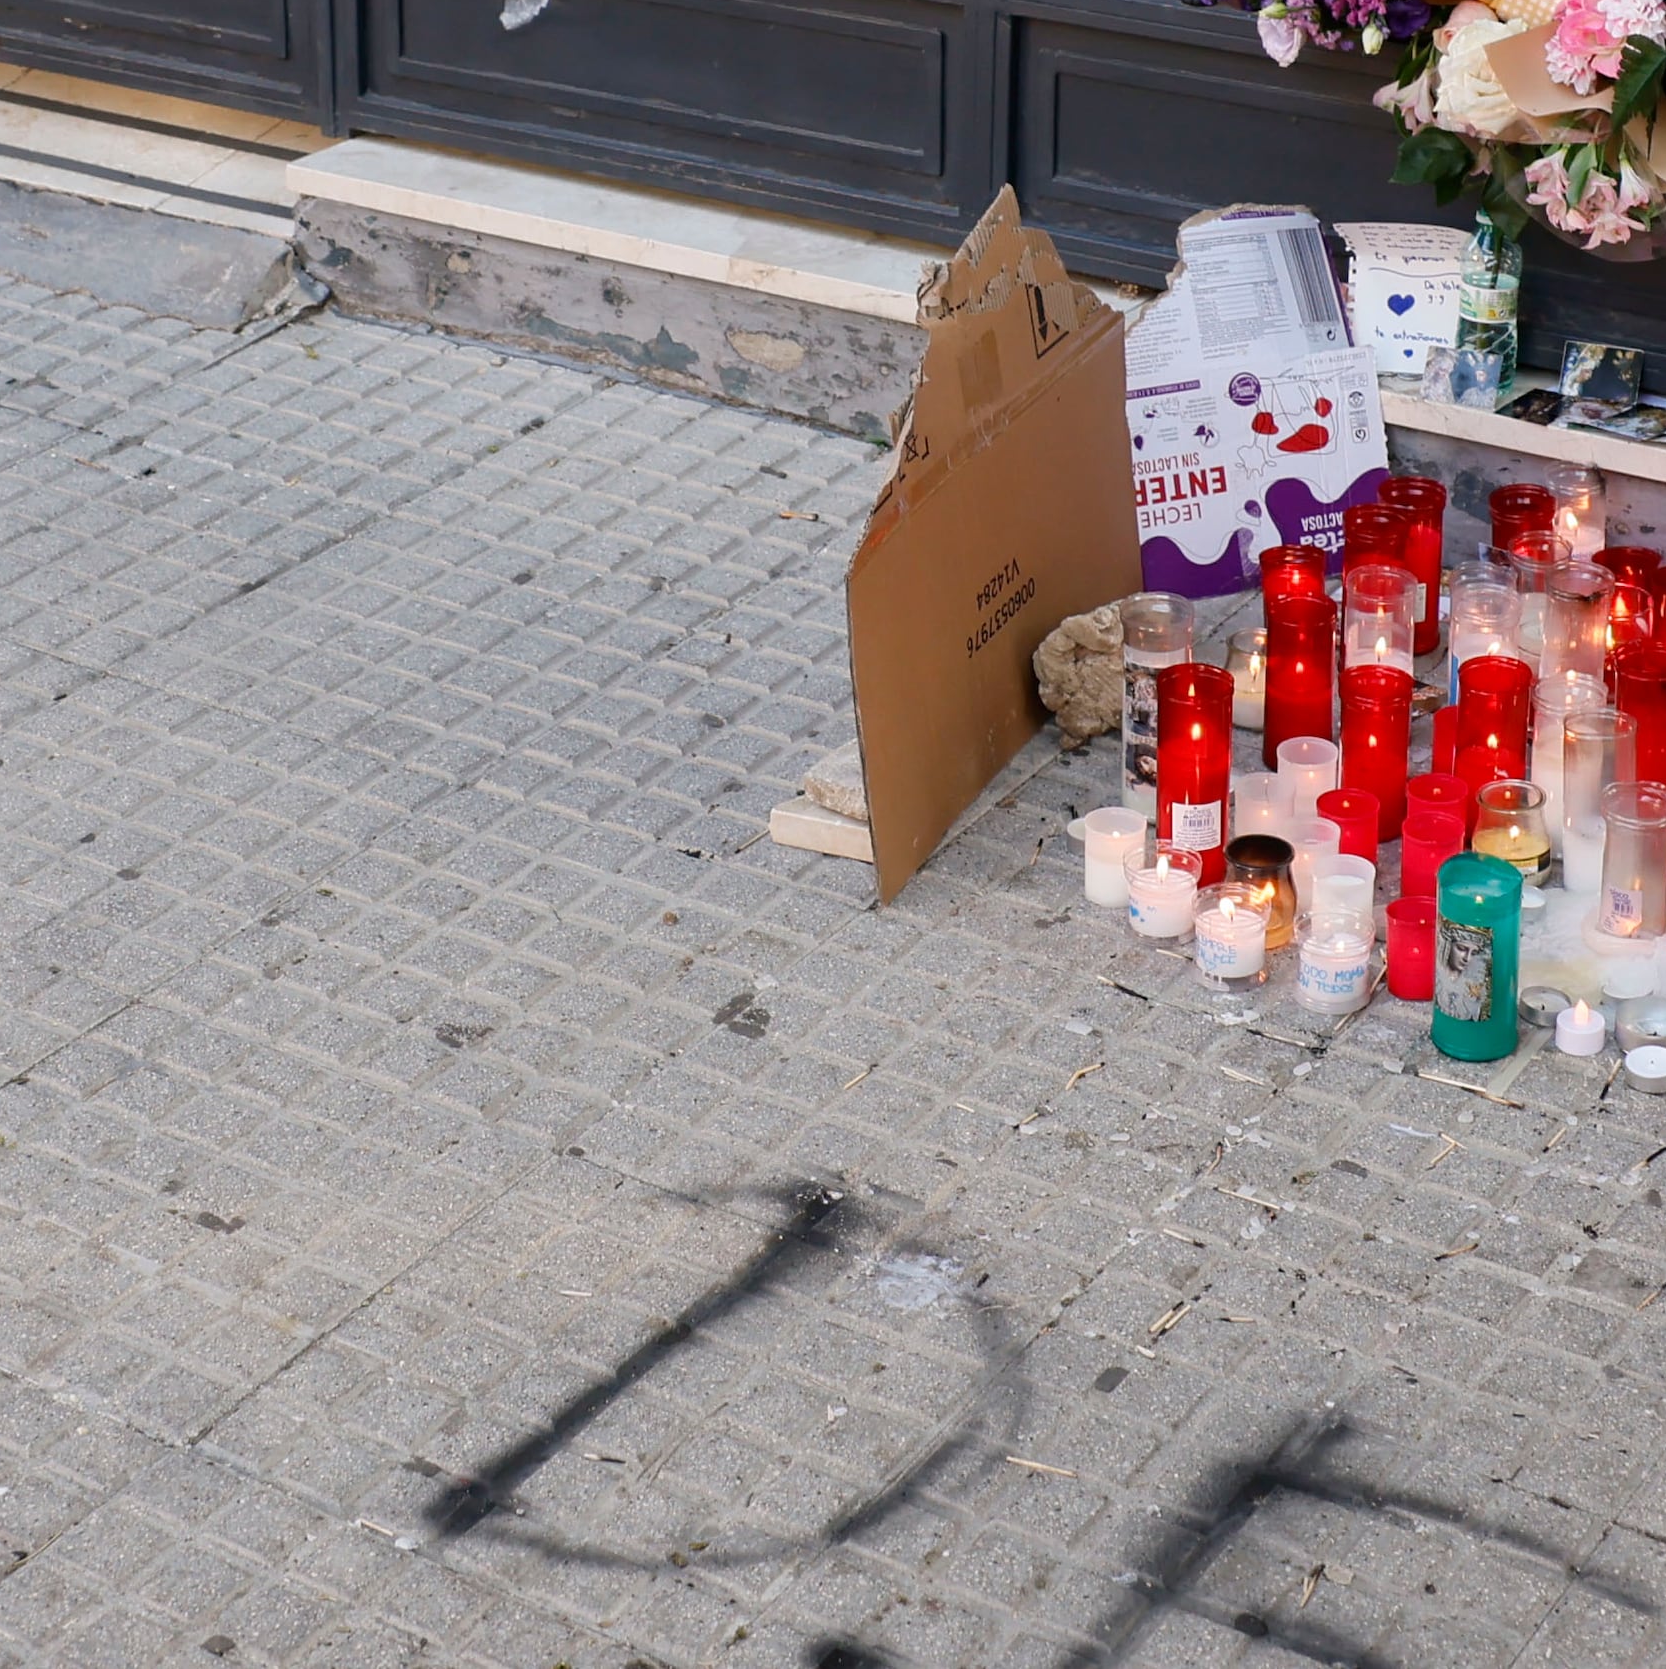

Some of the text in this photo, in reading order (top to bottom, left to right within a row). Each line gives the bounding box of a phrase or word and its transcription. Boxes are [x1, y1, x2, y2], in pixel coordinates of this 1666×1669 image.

[1182, 452, 1200, 468] SIN
[1140, 502, 1202, 528] LECHE
[976, 557, 1020, 610] V14284
[966, 577, 1035, 658] 0060537976
